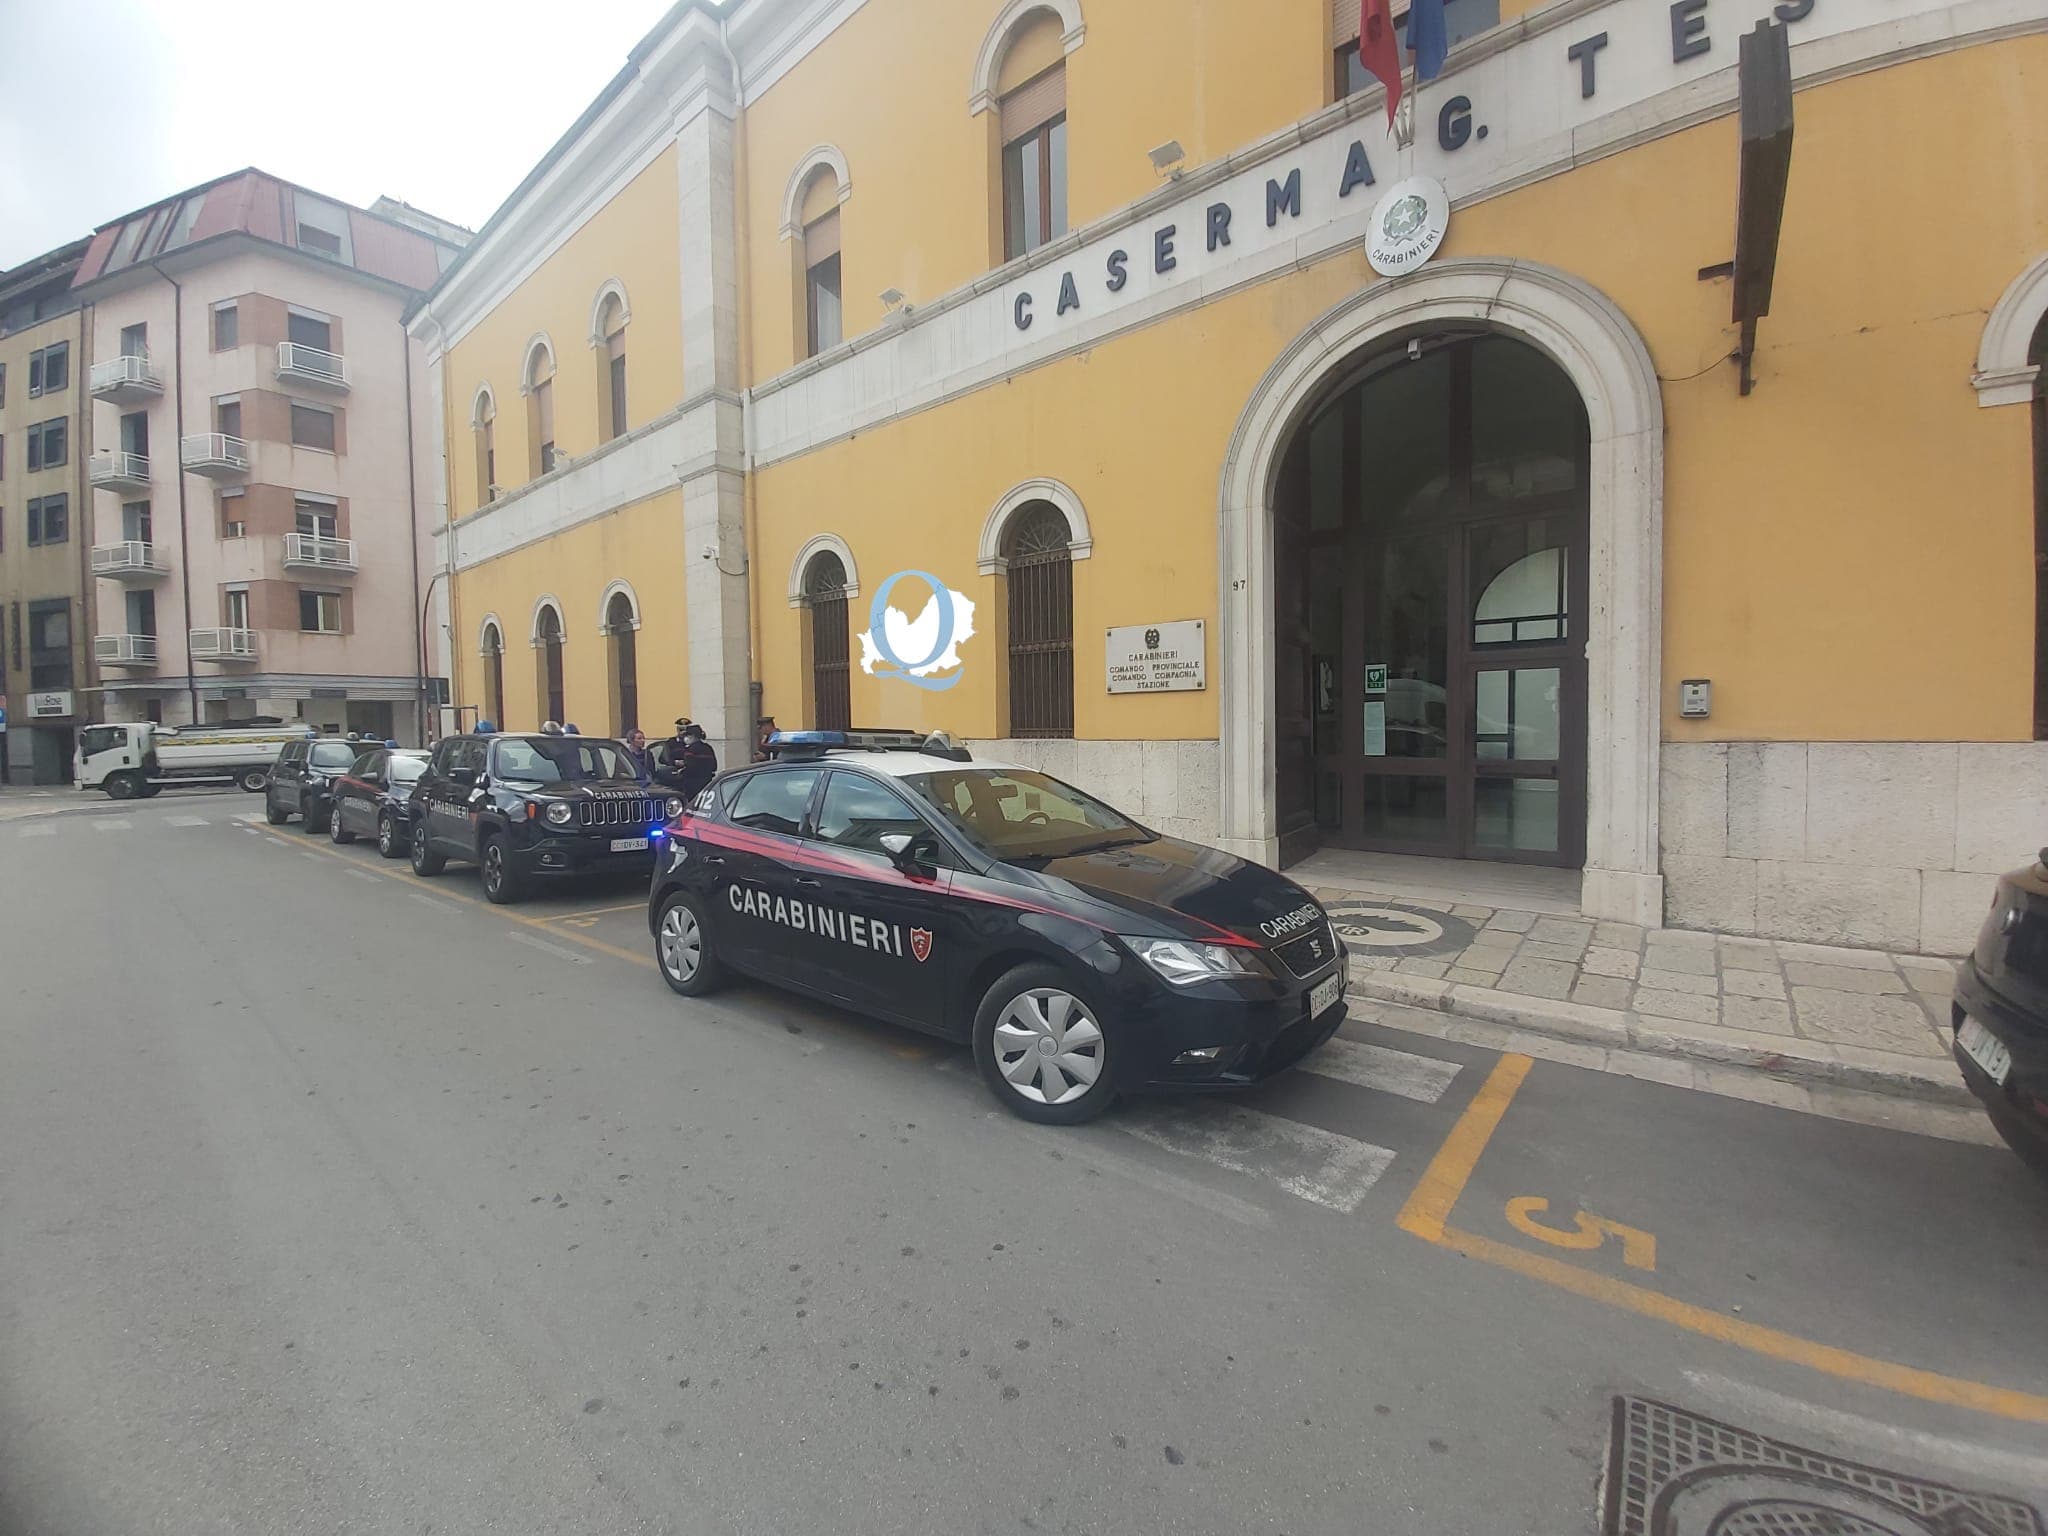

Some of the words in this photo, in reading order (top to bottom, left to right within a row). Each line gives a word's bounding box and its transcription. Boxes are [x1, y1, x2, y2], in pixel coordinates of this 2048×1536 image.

[1013, 139, 1376, 331] CASERMA
[1438, 94, 1489, 153] G.
[1372, 229, 1439, 265] CARABINIERI
[1128, 650, 1178, 662] CARABINIERI
[1109, 665, 1145, 674] COMANDO
[1152, 661, 1200, 671] PROVINCIALE
[1112, 673, 1147, 682] COMANDO
[1154, 670, 1197, 680] COMPAGNIA
[1136, 680, 1170, 689] STAZIONE
[594, 790, 650, 800] CARABINIERI
[694, 789, 715, 810] 112
[429, 799, 470, 821] CARABINIERI
[729, 884, 903, 957] CARABINIERI
[1504, 1195, 1657, 1272] 5
